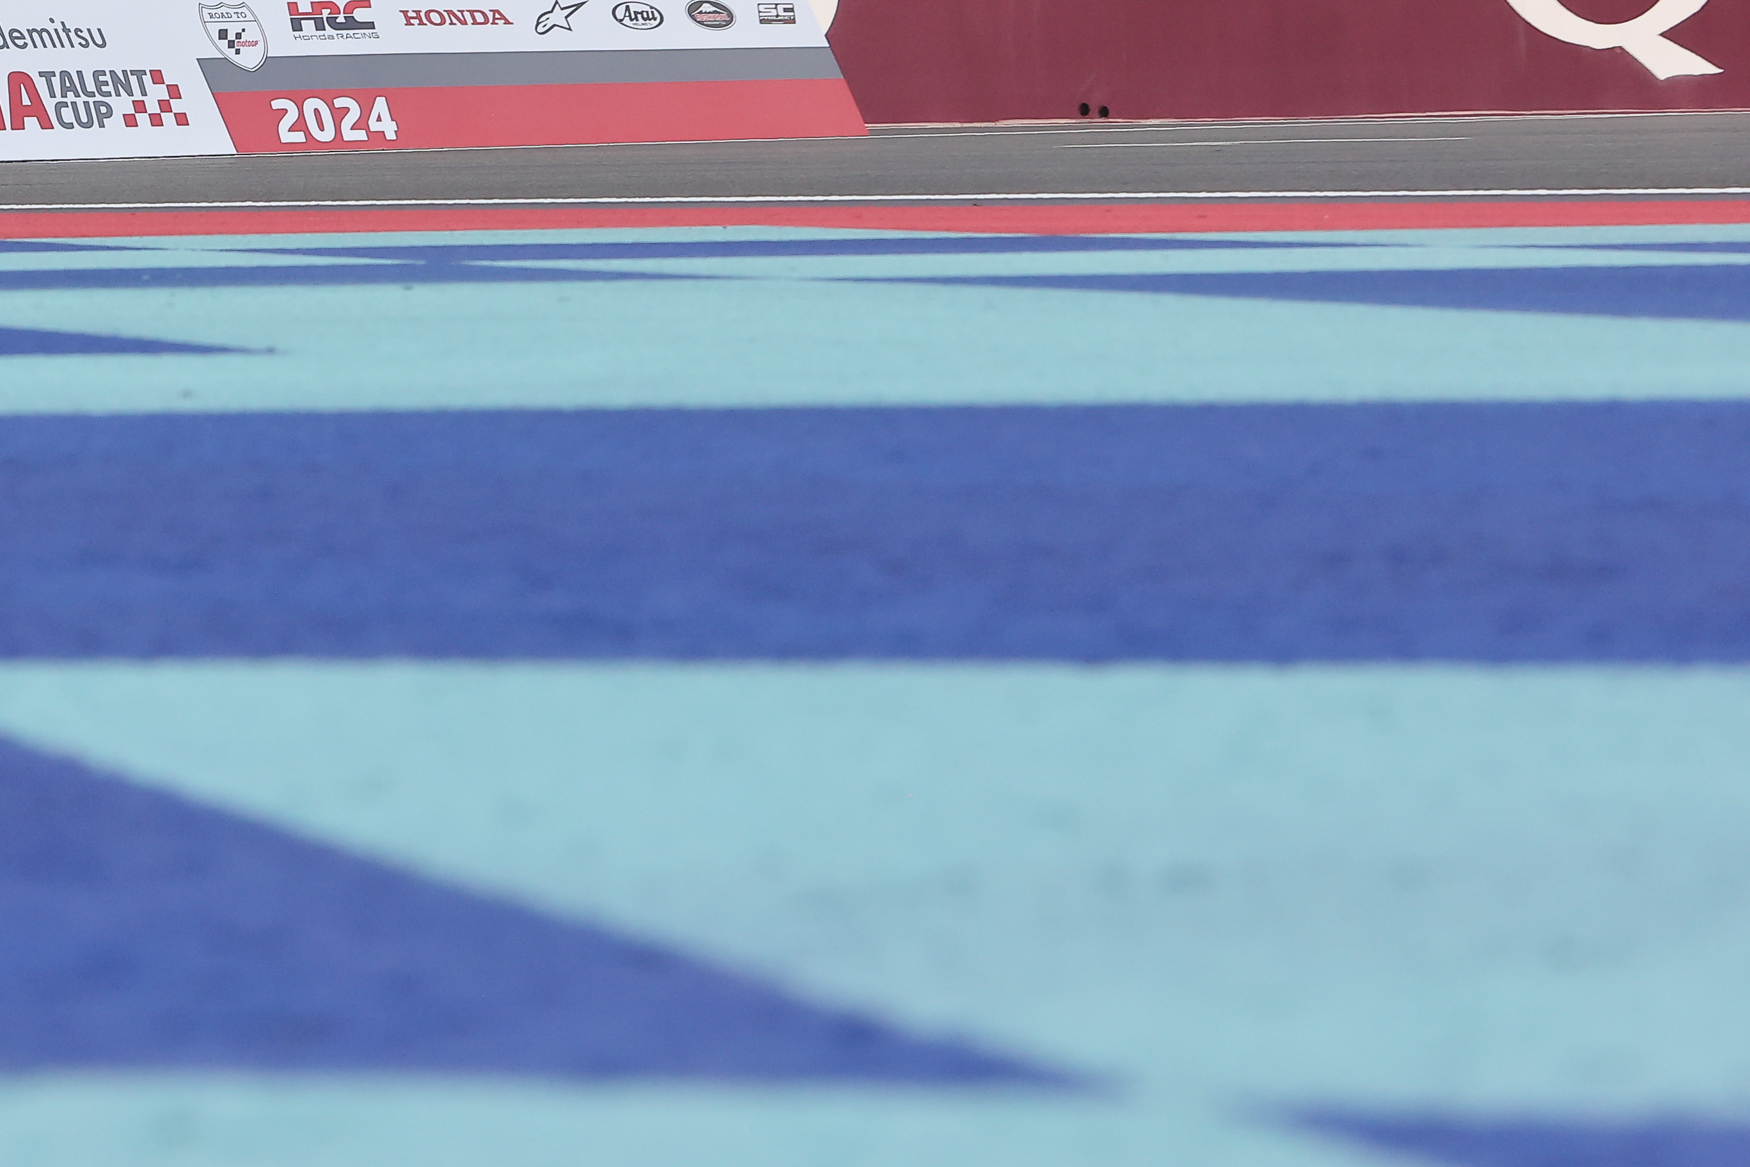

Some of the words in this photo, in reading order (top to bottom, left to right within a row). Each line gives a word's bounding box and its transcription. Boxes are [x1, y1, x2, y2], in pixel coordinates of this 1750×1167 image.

[207, 11, 233, 20] ROAD
[234, 11, 247, 19] TO
[286, 0, 376, 32] HRC
[399, 9, 514, 27] HONDA
[618, 4, 658, 22] Arai
[293, 33, 335, 41] Honda
[336, 32, 380, 40] RACING
[38, 69, 147, 98] TALENT
[54, 100, 113, 129] CUP
[270, 96, 398, 144] 2024
